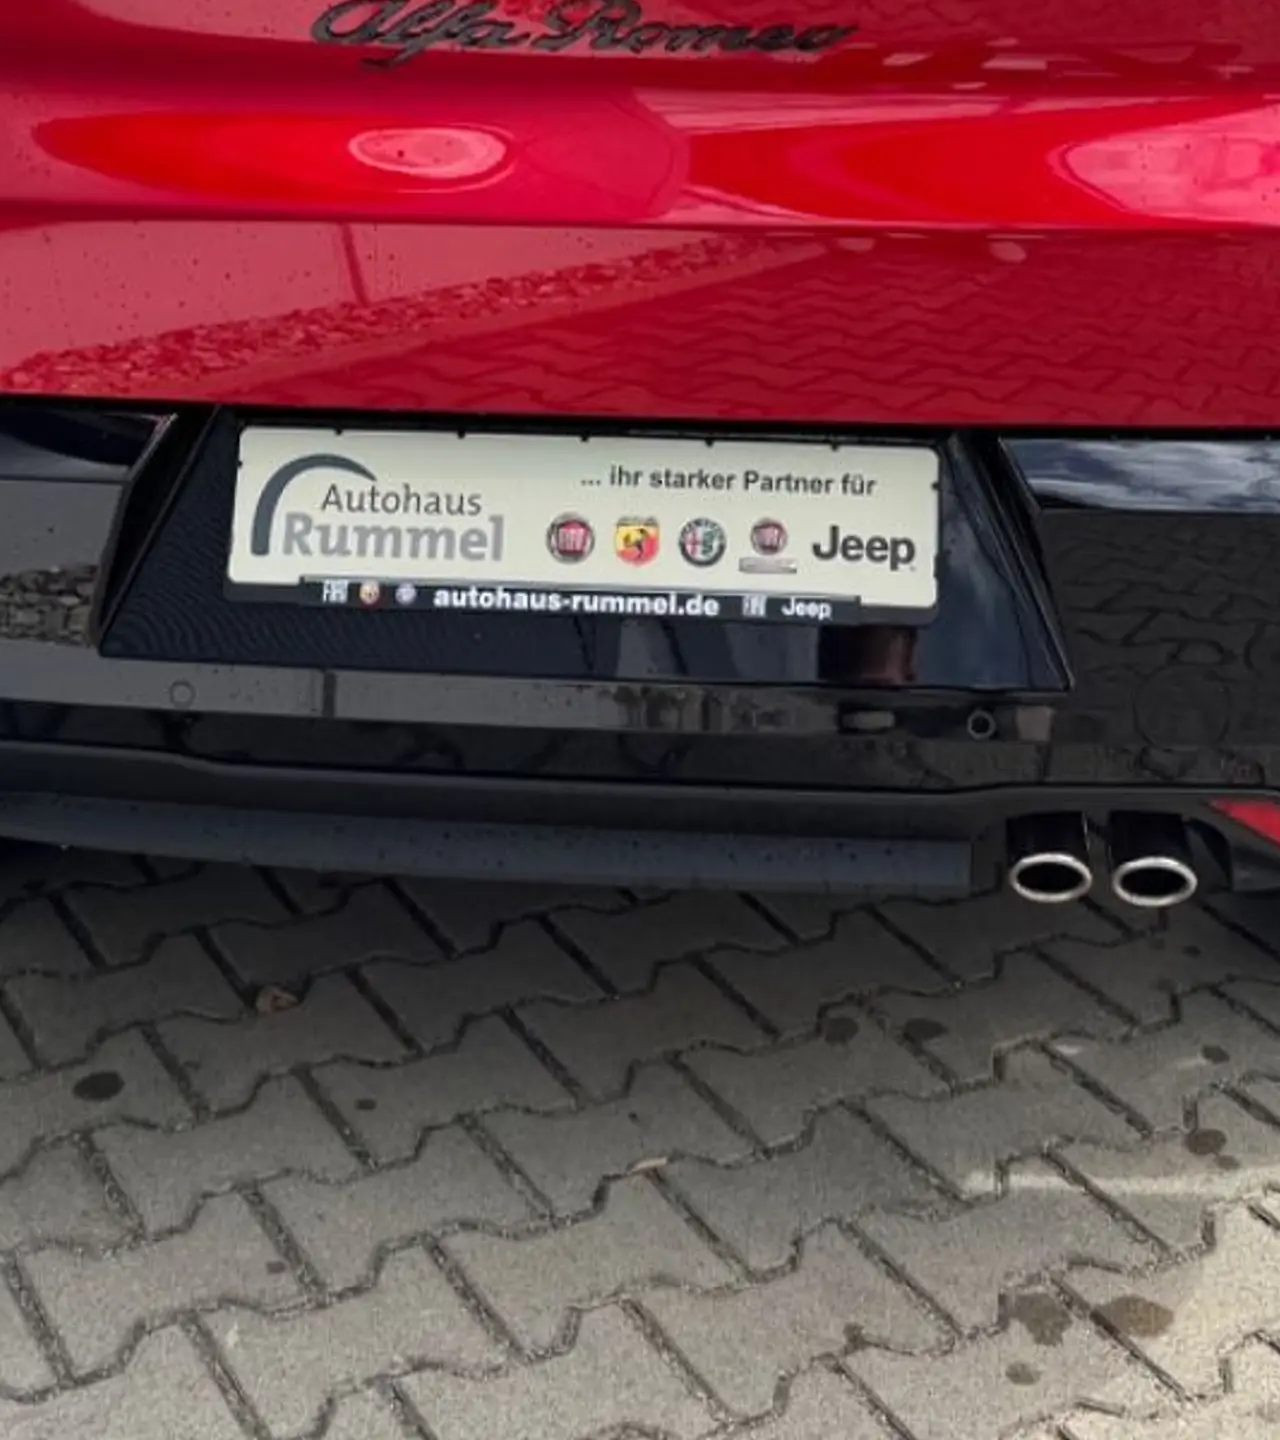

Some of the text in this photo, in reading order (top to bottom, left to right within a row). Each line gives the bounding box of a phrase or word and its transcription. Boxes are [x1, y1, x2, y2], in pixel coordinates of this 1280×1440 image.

[609, 465, 644, 488] ihr
[648, 468, 735, 491] starker
[743, 470, 834, 494] Partner
[840, 473, 877, 496] für
[320, 482, 483, 516] Autohaus
[282, 512, 505, 561] Rummel
[812, 525, 916, 572] Jeep
[433, 587, 720, 617] autohaus-rummel.de
[781, 597, 833, 620] Jeep
